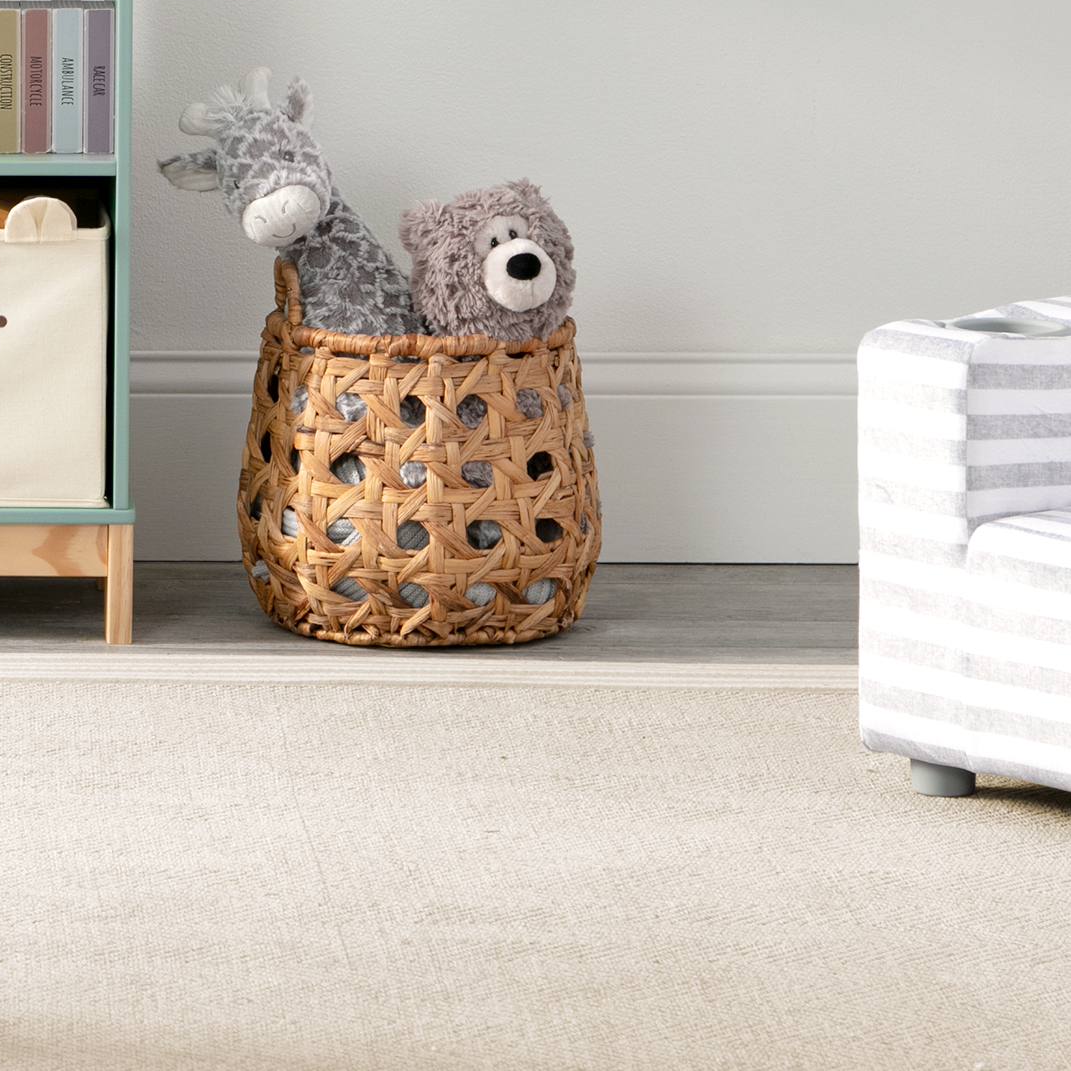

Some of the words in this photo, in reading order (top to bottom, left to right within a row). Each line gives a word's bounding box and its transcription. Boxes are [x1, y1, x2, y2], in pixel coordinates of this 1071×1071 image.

[0, 53, 13, 110] CONSTRUCTION
[29, 56, 43, 107] MOTORCYCLE
[61, 57, 74, 106] AMBULANCE
